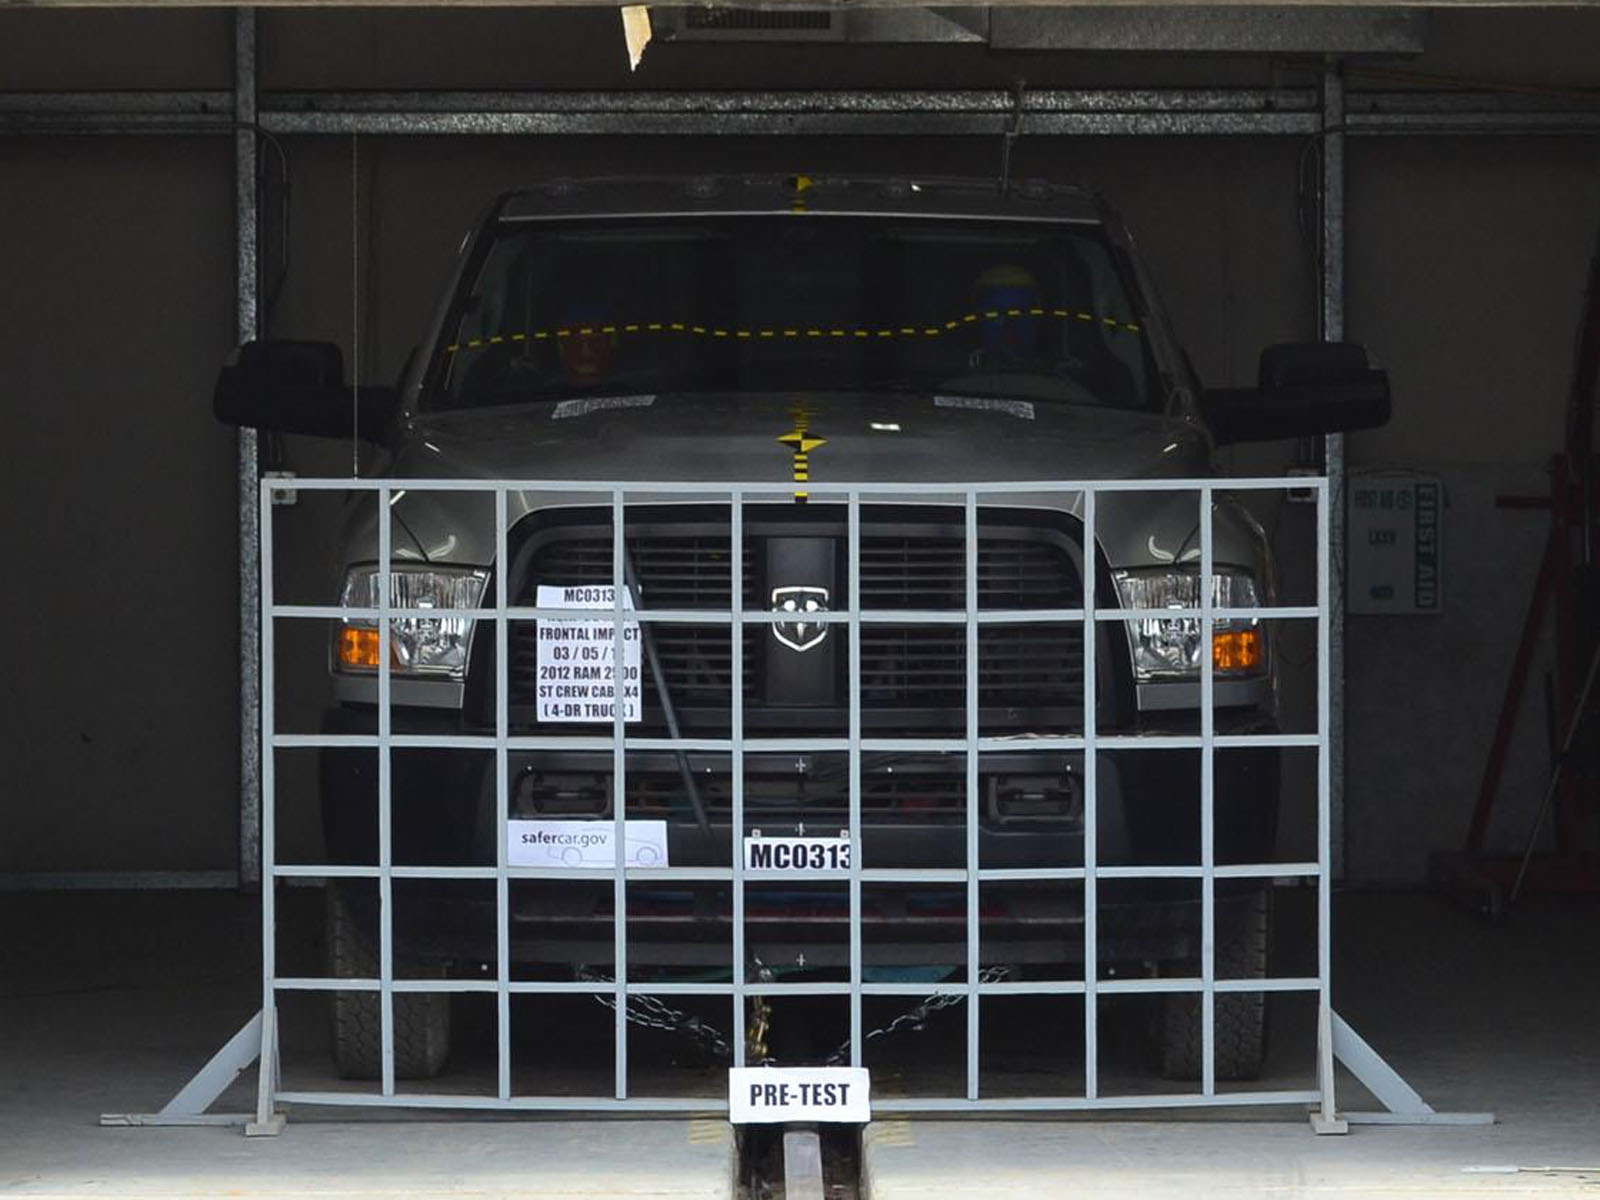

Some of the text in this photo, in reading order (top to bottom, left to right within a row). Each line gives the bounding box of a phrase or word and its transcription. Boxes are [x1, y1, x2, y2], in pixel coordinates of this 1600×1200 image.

[1419, 487, 1436, 606] FIRST AID
[564, 588, 615, 602] MC0313
[540, 627, 639, 640] FRONTAL IMPCT
[553, 646, 569, 660] 03
[582, 646, 599, 660] 05
[540, 666, 638, 679] 2012 RAM 200
[539, 685, 552, 698] ST
[556, 685, 589, 698] CREW
[592, 685, 614, 698] CAB
[551, 704, 581, 717] 4-DR
[584, 704, 627, 717] TRUC
[521, 830, 607, 847] safercar.gov
[750, 843, 850, 869] MC0313
[750, 1083, 850, 1106] PRE-TEST
